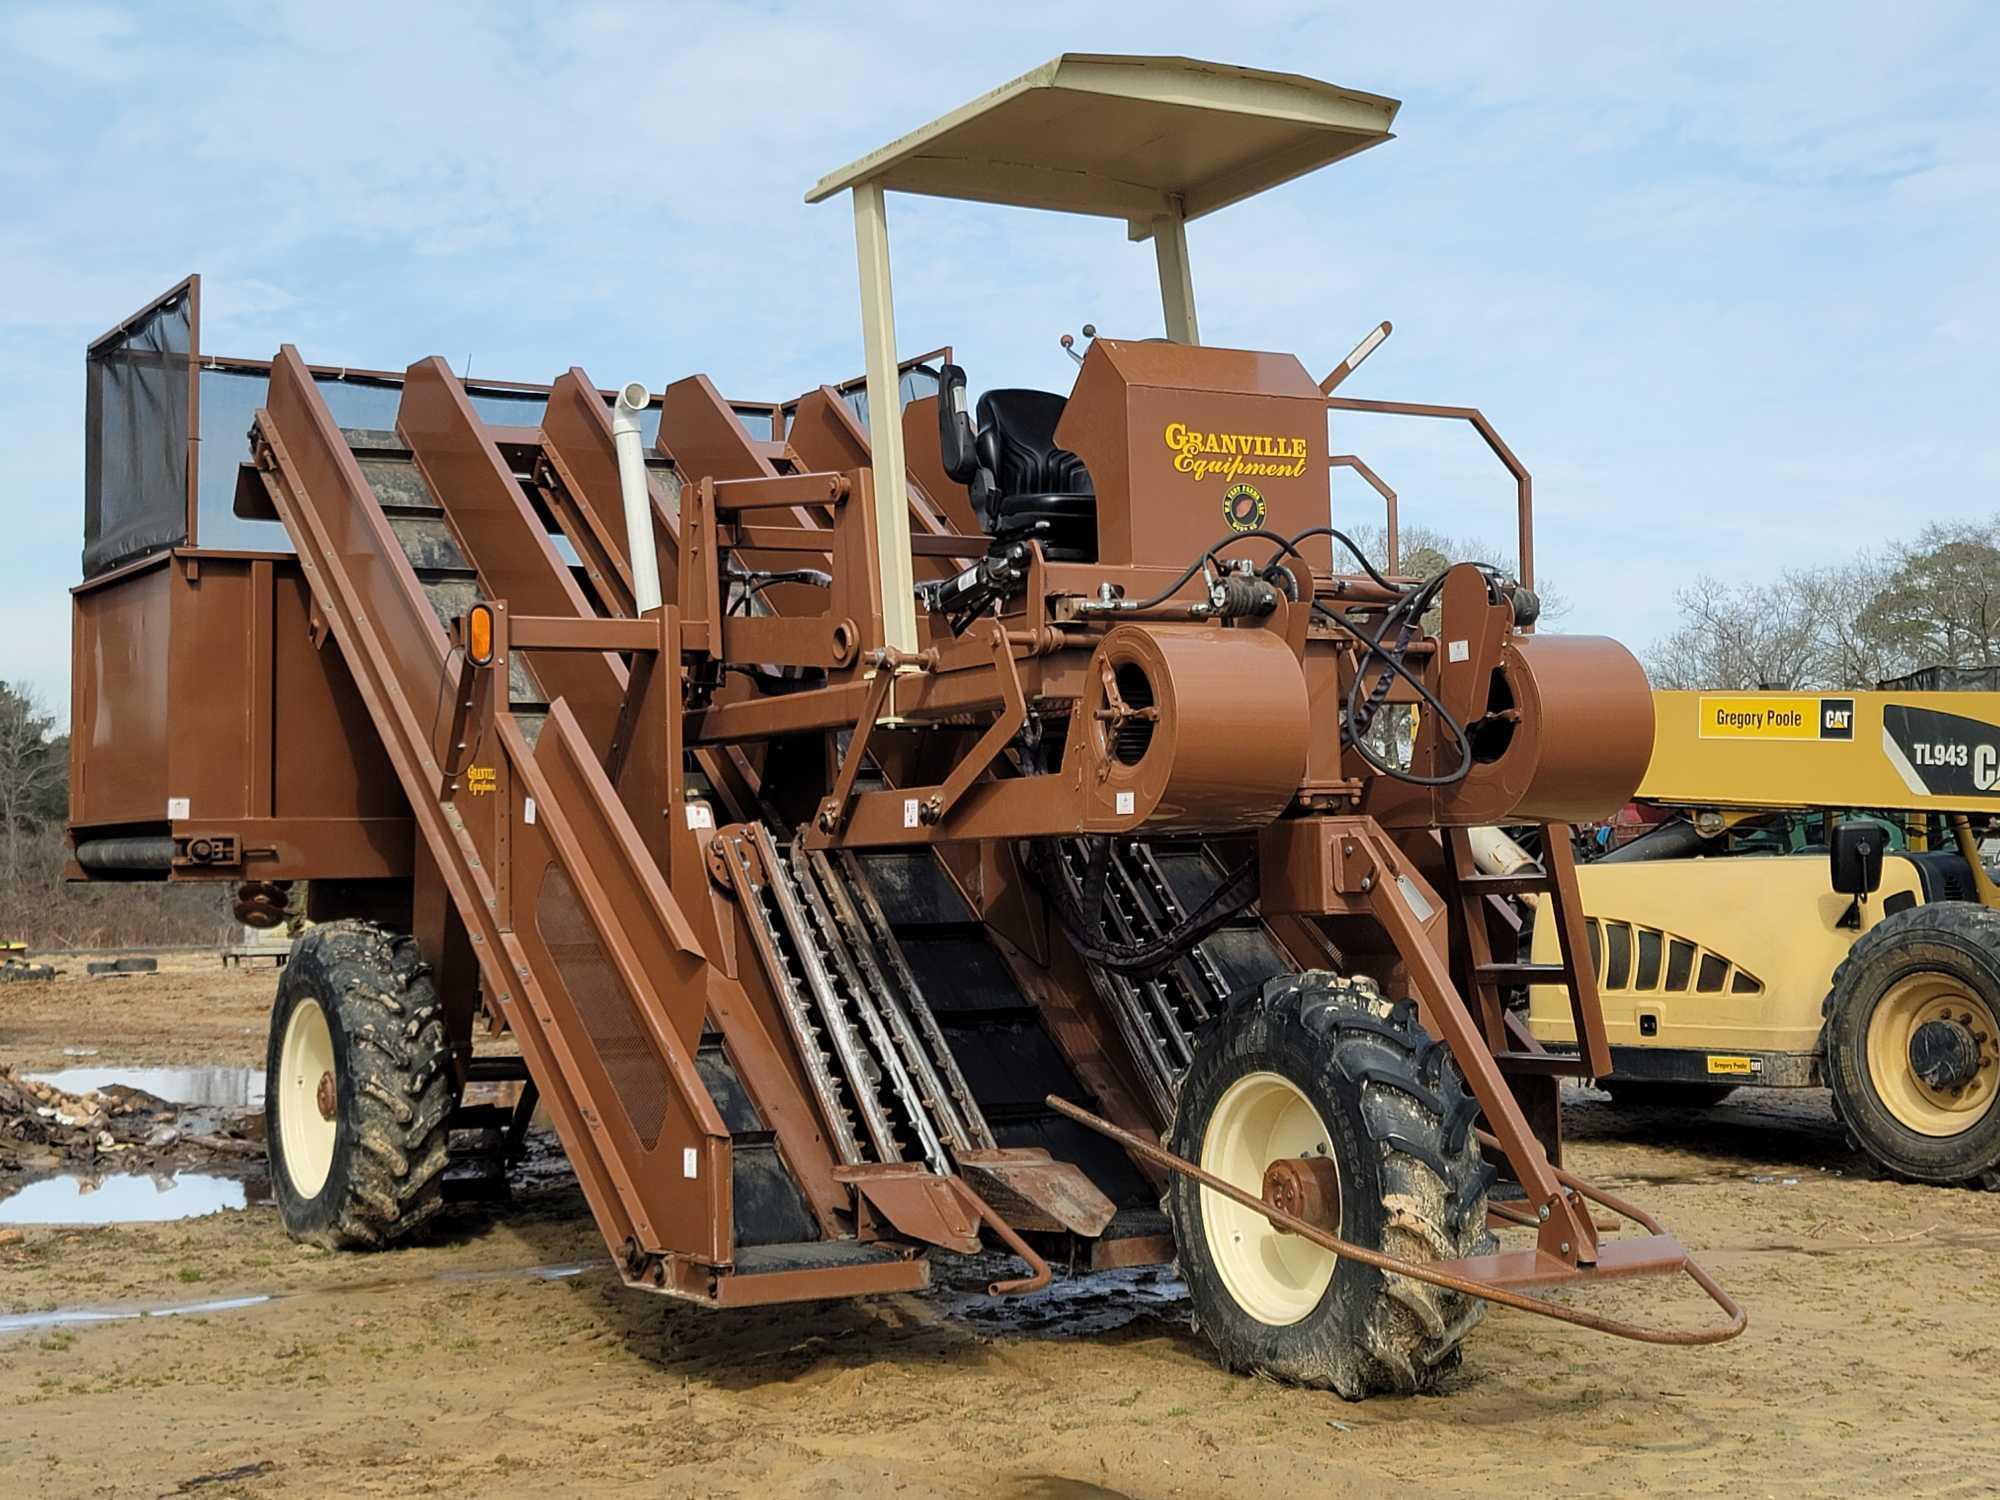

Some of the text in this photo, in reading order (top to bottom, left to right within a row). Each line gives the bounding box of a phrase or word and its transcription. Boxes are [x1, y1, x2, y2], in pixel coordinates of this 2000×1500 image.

[1165, 423, 1307, 458] GRANVILLE
[1174, 442, 1307, 482] Equipment
[1717, 709, 1802, 729] Gregory Poole
[1825, 710, 1851, 729] CAT
[1913, 743, 1968, 767] TL943
[1974, 744, 2000, 791] C
